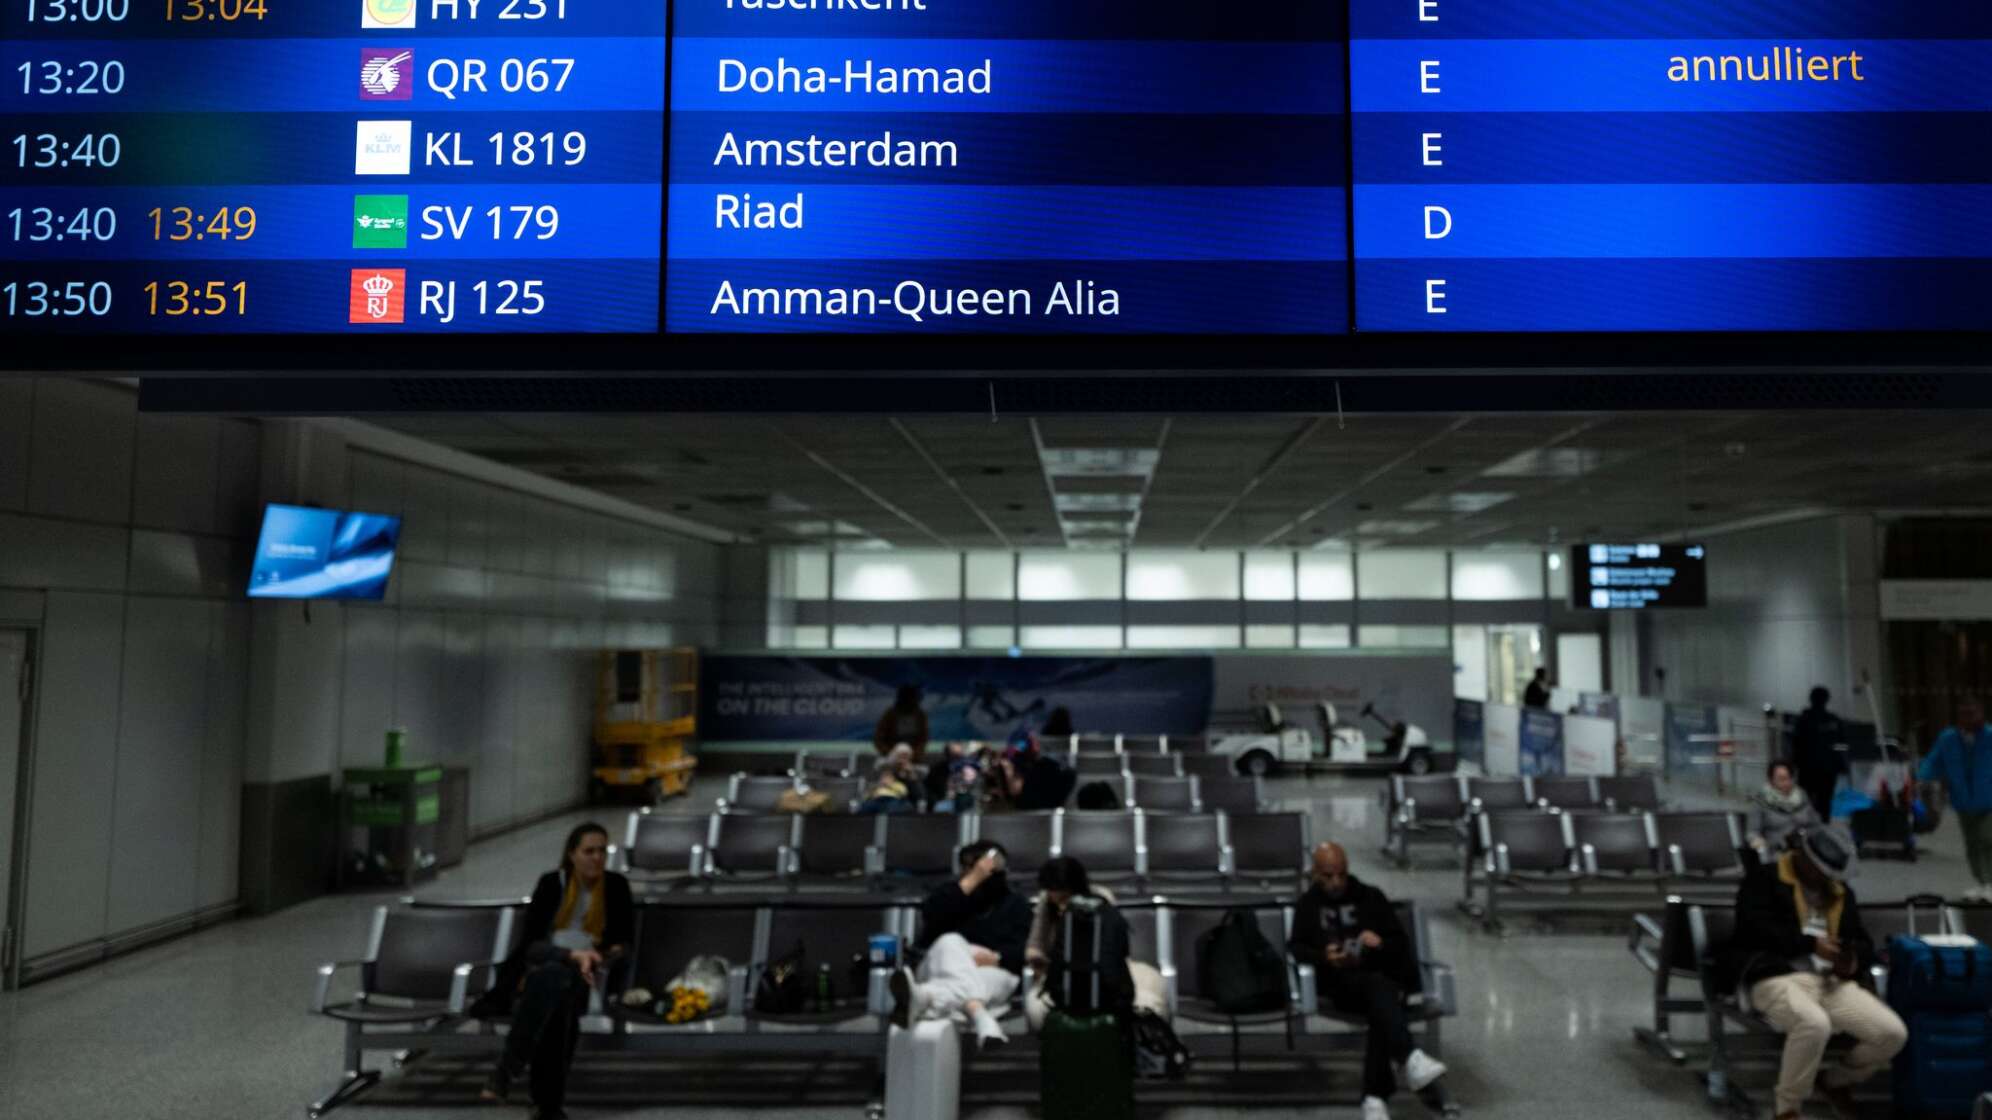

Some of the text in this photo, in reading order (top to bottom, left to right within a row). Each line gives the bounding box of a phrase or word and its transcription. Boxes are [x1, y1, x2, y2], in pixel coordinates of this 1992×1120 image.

[28, 0, 129, 21] 13:00
[1418, 0, 1439, 21] E
[17, 60, 125, 94] 13:20
[427, 58, 575, 99] QR 067
[718, 57, 991, 94] Doha-Hamad
[1420, 60, 1441, 94] E
[1667, 46, 1864, 82] annulliert
[13, 133, 121, 168] 13:40
[365, 143, 401, 154] KLM
[425, 131, 586, 166] KL 1819
[713, 131, 957, 167] Amsterdam
[1422, 132, 1443, 166] E
[8, 207, 116, 241] 13:40
[149, 206, 257, 241] 13:49
[420, 205, 559, 240] SV 179
[716, 193, 803, 229] Riad
[1424, 205, 1452, 240] D
[3, 281, 112, 316] 13:50
[144, 280, 246, 315] 13:51
[420, 280, 545, 323] RJ 125
[710, 280, 1120, 322] Amman-Queen Alia
[1426, 280, 1447, 314] E
[716, 698, 865, 716] ON THE CLOUD
